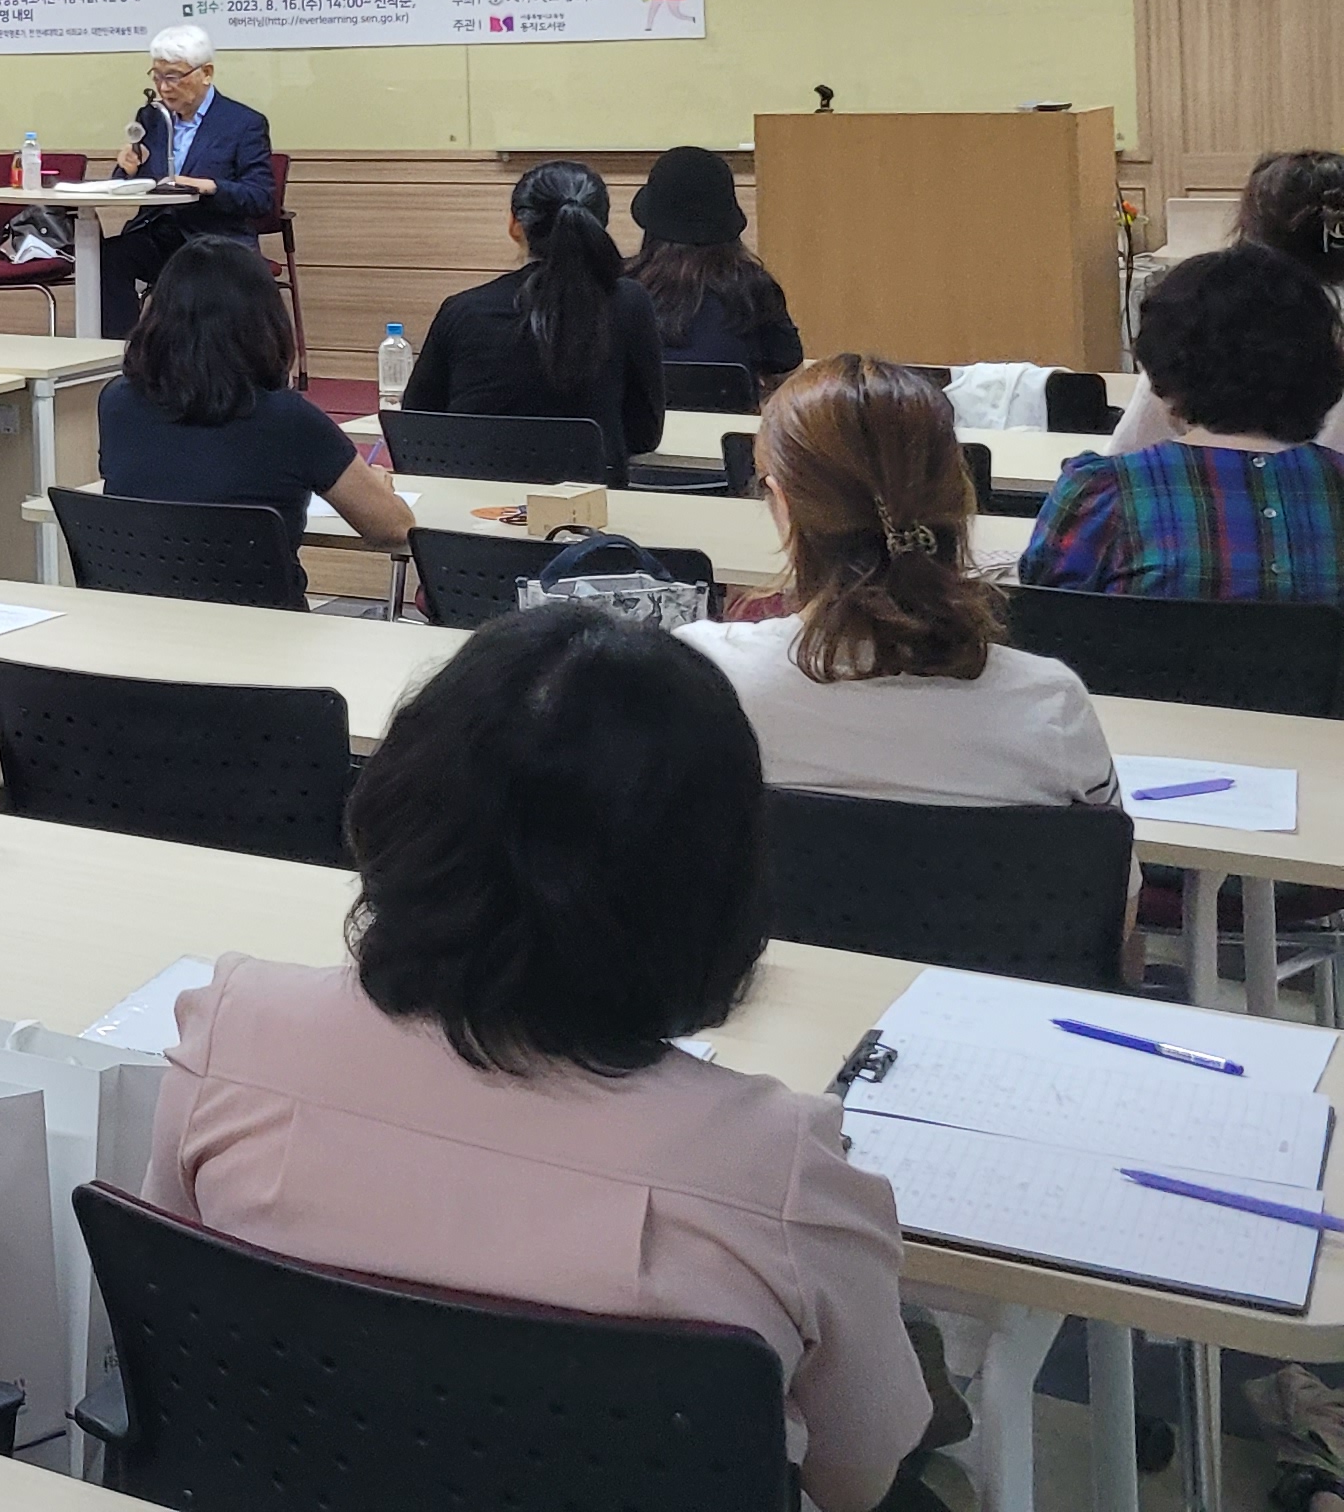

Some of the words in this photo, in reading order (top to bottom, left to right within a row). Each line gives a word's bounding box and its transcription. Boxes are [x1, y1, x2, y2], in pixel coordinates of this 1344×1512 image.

[226, 0, 263, 12] 2023.
[265, 0, 278, 11] 8.
[12, 8, 33, 22] 내외
[453, 18, 476, 32] 주관
